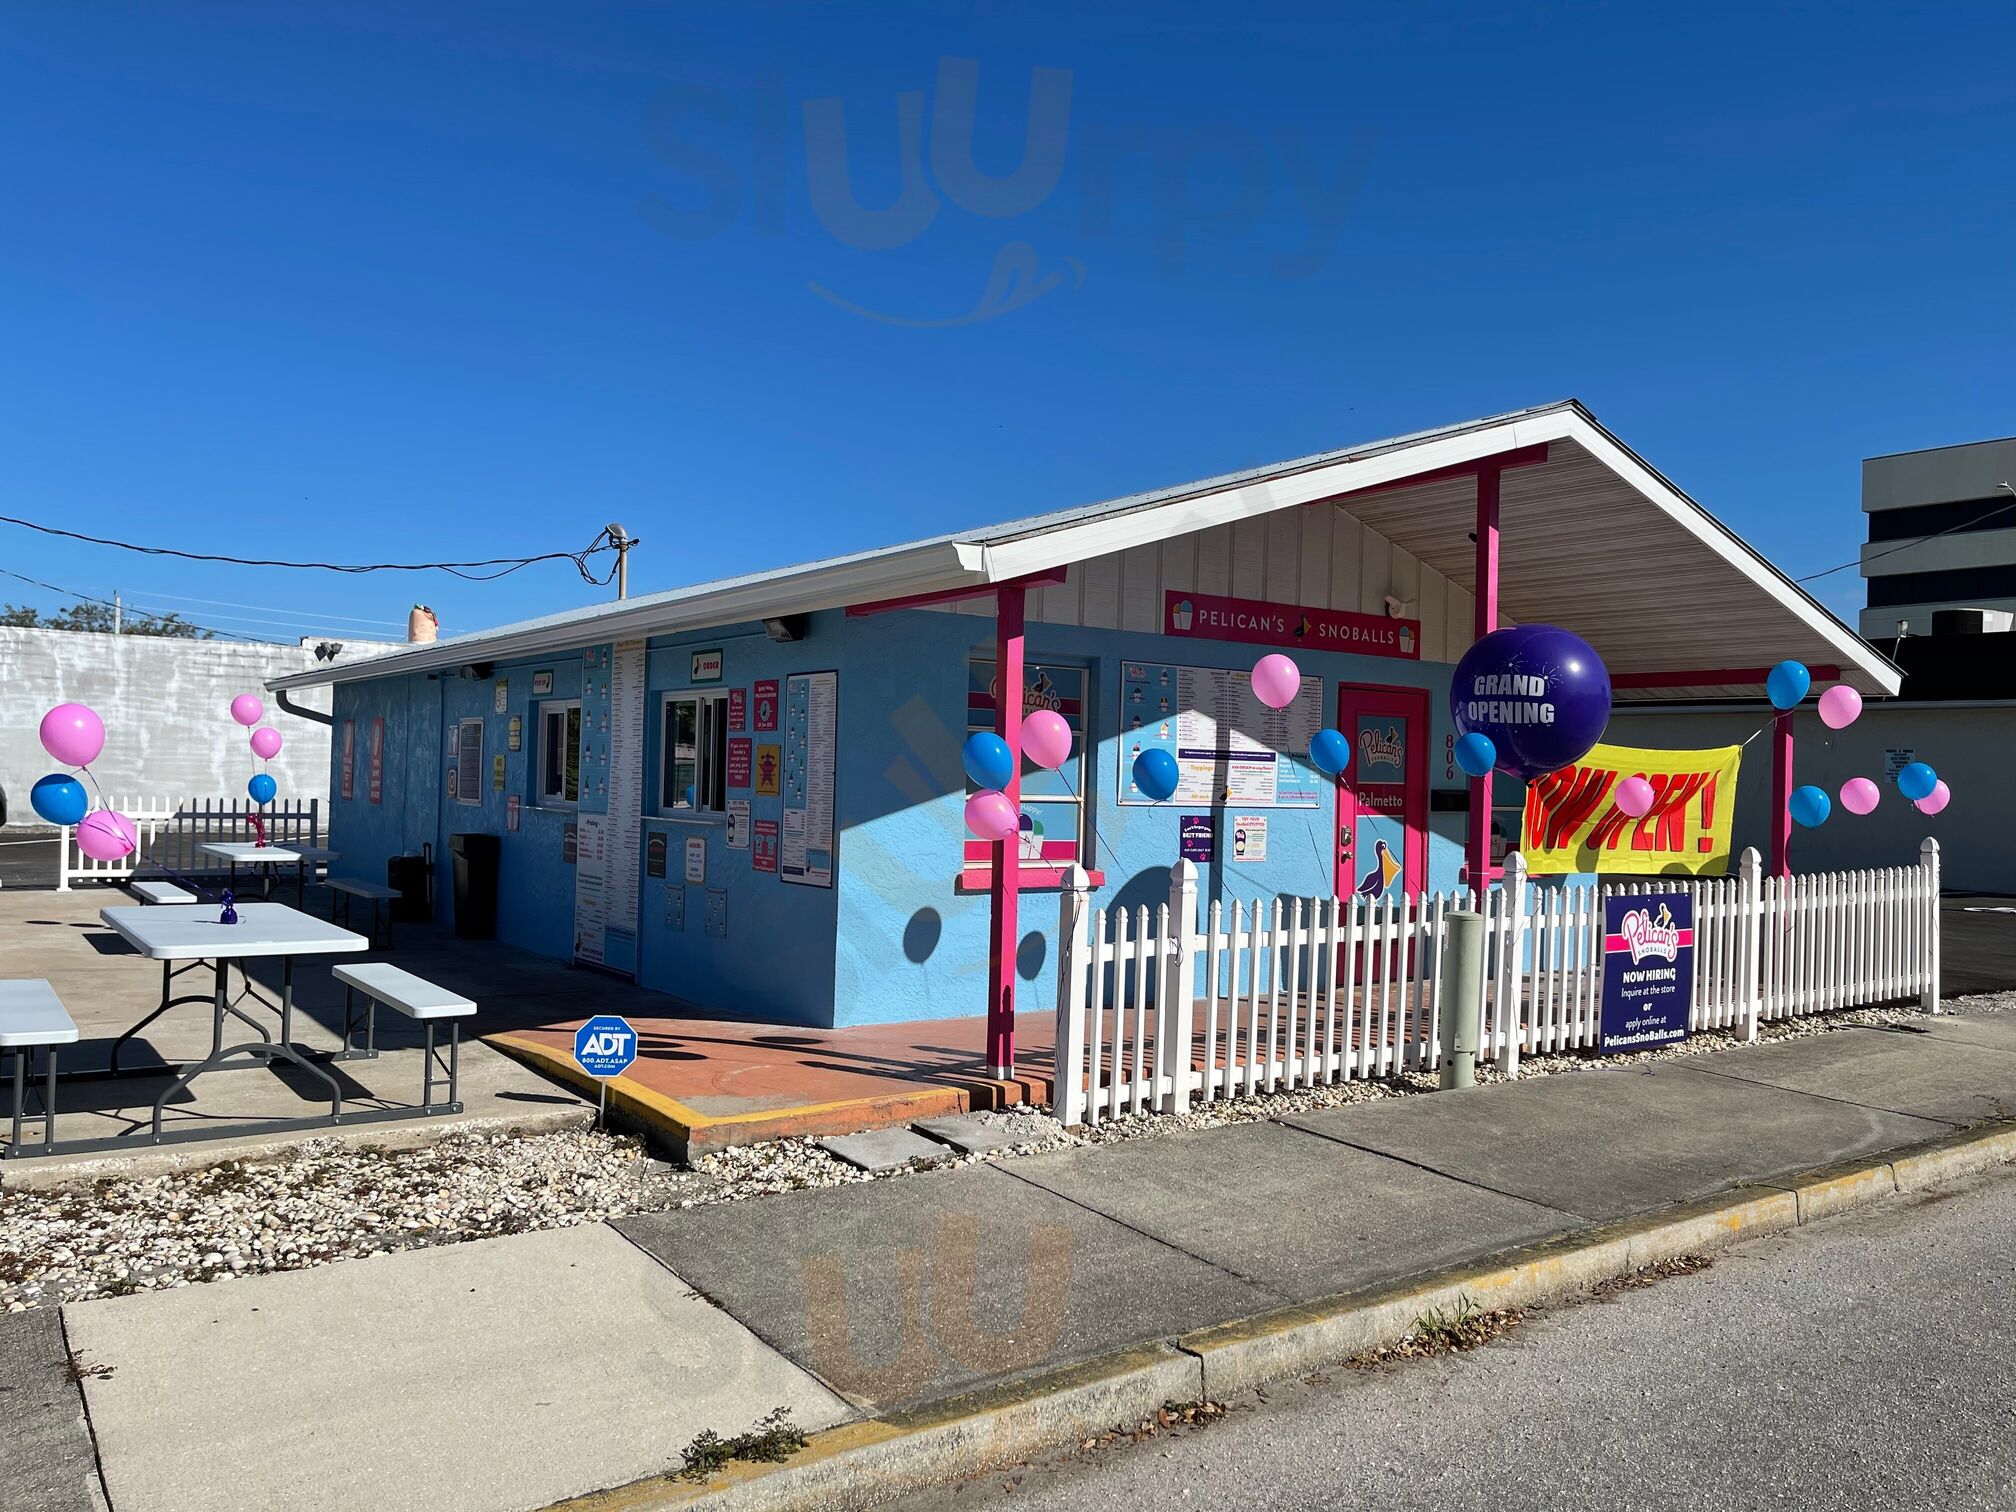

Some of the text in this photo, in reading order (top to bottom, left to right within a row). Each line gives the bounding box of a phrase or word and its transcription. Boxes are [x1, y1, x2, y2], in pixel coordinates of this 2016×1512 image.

[1199, 609, 1395, 645] PELICAN'S SNOBALLS
[703, 661, 719, 670] ORDER
[1474, 673, 1545, 697] GRAND
[1467, 701, 1555, 724] OPENING
[1359, 728, 1403, 768] Pelican's
[1190, 764, 1215, 772] Toppings
[1358, 791, 1403, 807] Palmetto
[1622, 908, 1680, 966] Pelican's
[1637, 947, 1667, 957] SNOBALLS
[1622, 968, 1676, 983] NOW HIRING
[1621, 985, 1676, 1000] Inquire at the store
[1643, 1003, 1652, 1011] or
[1625, 1015, 1667, 1032] apply online at
[580, 1033, 632, 1056] ADT
[1604, 1029, 1685, 1048] PelicansSnoBalls.com
